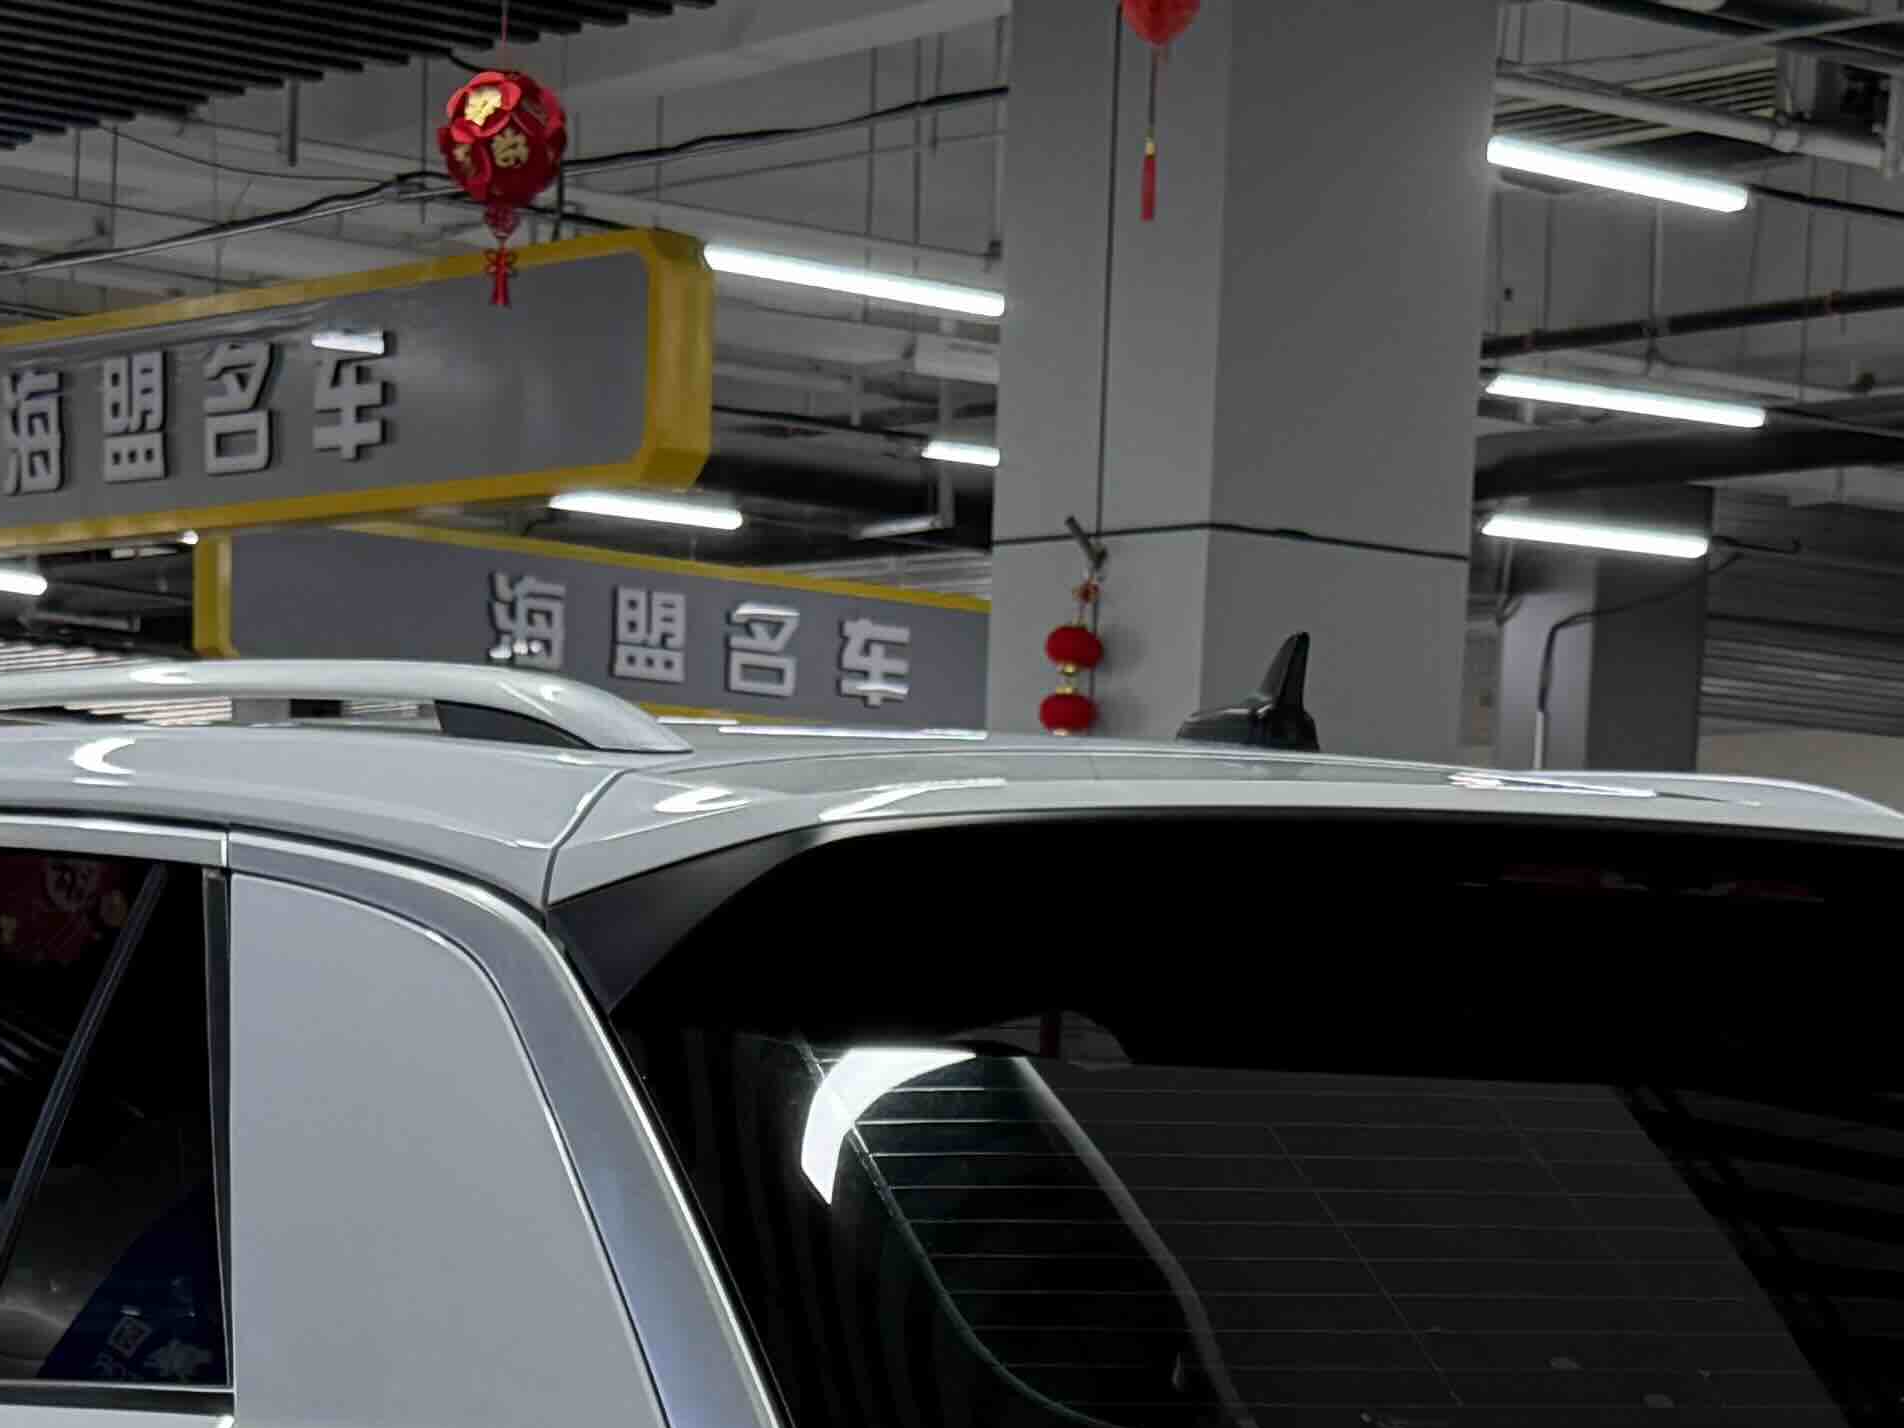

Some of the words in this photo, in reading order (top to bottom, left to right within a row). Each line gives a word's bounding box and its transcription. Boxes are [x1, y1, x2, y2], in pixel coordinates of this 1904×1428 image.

[1, 329, 386, 496] 海盟名车
[489, 573, 910, 706] 海盟名车
